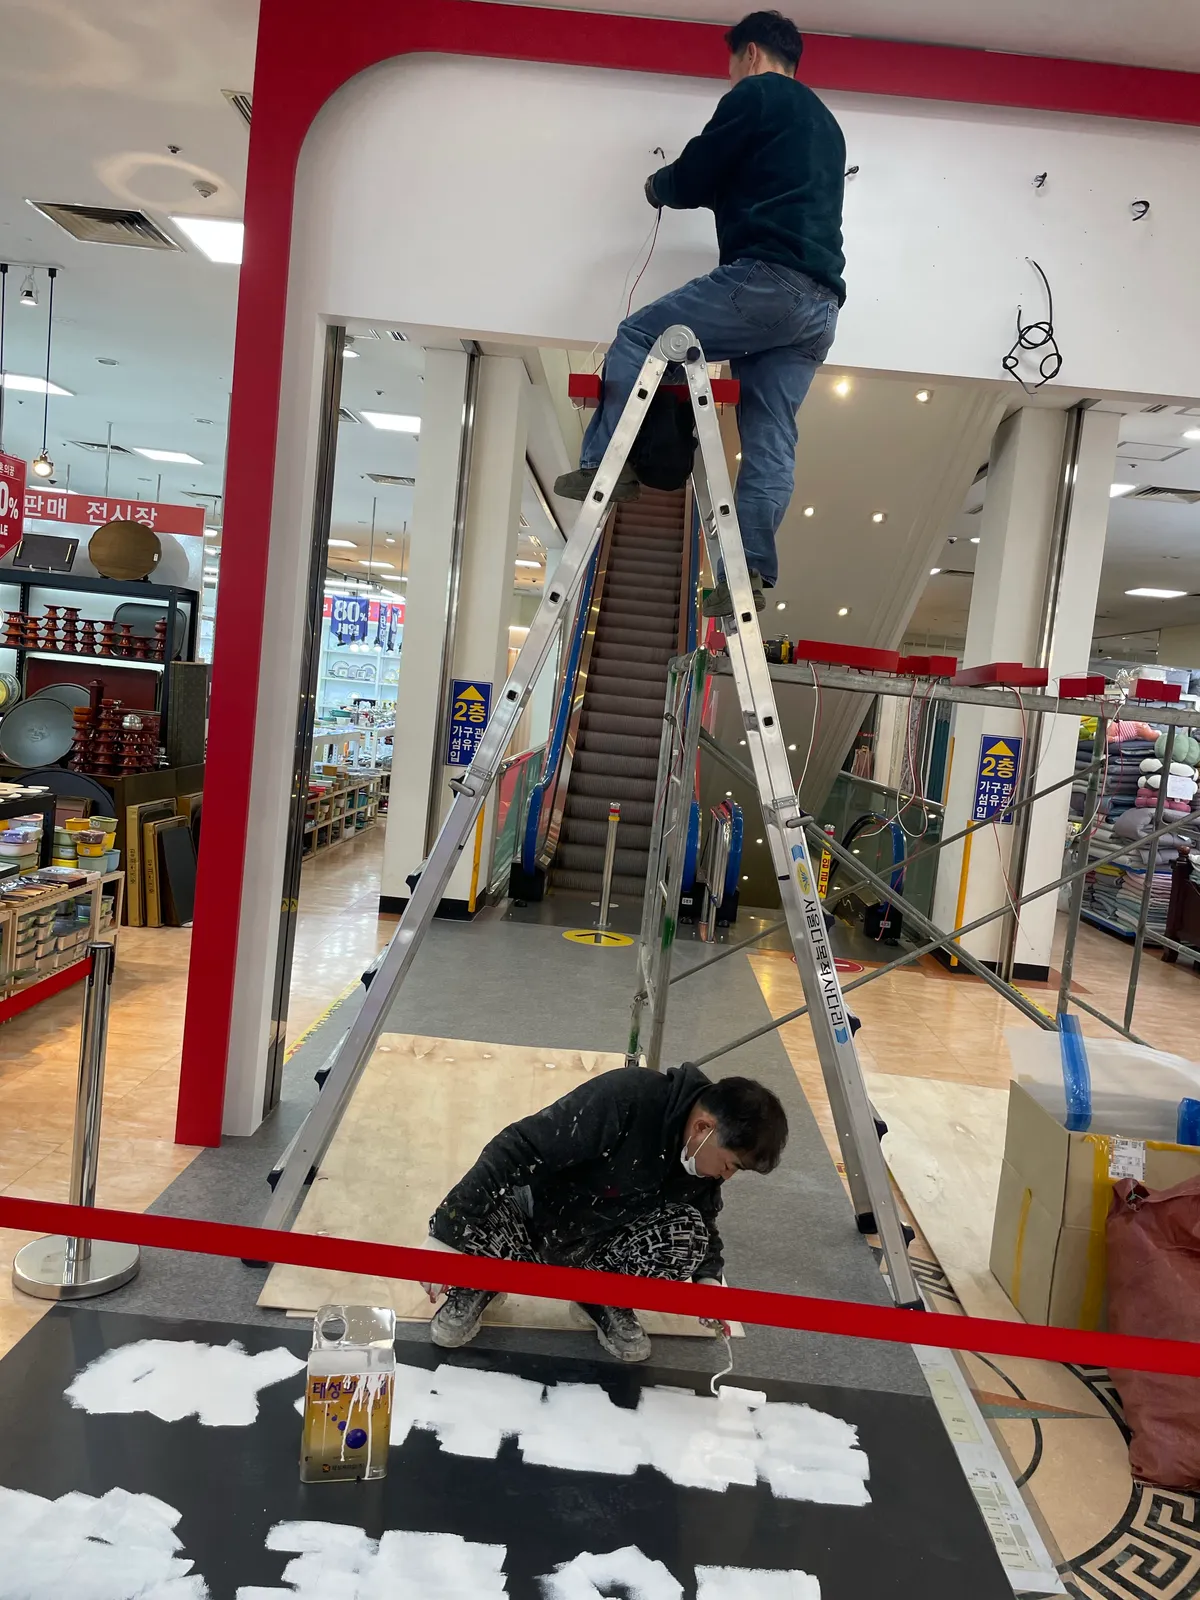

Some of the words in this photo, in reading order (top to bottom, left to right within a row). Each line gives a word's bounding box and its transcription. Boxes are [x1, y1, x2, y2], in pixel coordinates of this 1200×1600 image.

[24, 494, 68, 521] 판매
[86, 501, 158, 529] 전시장
[333, 599, 368, 623] 80%
[453, 701, 486, 723] 2층
[981, 756, 1015, 779] 2층
[979, 780, 1012, 796] 가구관
[803, 898, 844, 1026] 서울다목적사다리
